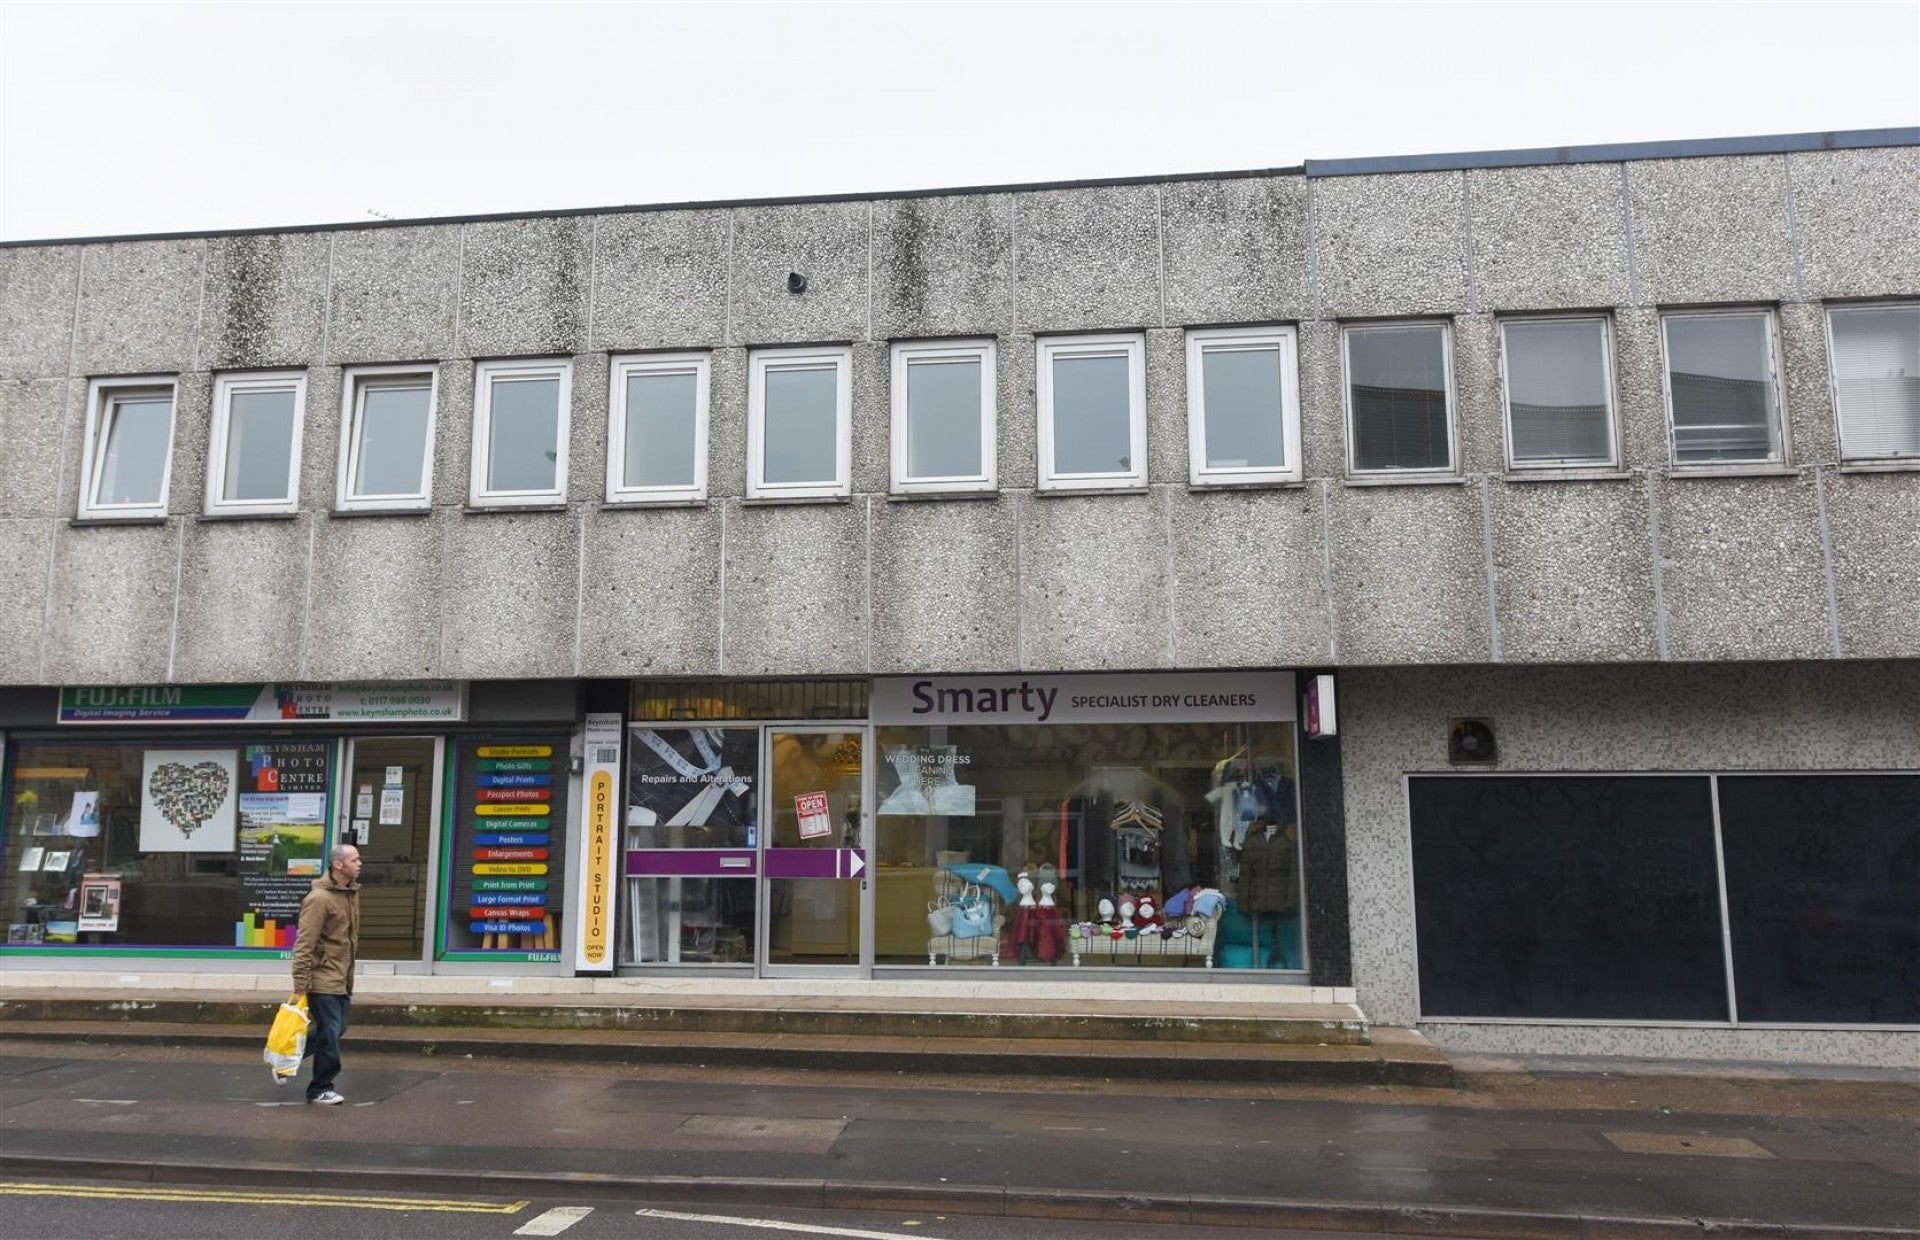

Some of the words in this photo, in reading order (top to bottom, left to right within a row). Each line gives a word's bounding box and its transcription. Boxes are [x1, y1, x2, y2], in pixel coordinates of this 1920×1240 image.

[912, 681, 1059, 722] Smarty
[1071, 695, 1148, 708] SPECIALIST
[1152, 695, 1180, 707] DRY
[1184, 694, 1257, 707] CLEANERS
[74, 709, 100, 719] Digital
[103, 709, 137, 719] Imaging
[139, 708, 171, 717] Service
[338, 706, 453, 719] www.keynshamphoto.co.uk
[262, 754, 325, 768] PHOTO
[884, 754, 935, 764] WEDDING
[937, 755, 971, 765] DRESS
[495, 762, 515, 770] Photo
[517, 762, 532, 770] Gifts
[267, 769, 324, 783] CENTRE
[492, 776, 514, 785] Digital
[515, 776, 535, 784] Prints
[641, 774, 678, 785] Repairs
[679, 774, 698, 783] and
[700, 774, 752, 784] Alterations
[912, 777, 941, 786] HERE
[487, 790, 515, 799] Passport
[516, 790, 539, 798] Photos
[800, 798, 824, 811] OPEN
[486, 820, 508, 829] Digital
[509, 820, 537, 828] Cameras
[595, 782, 605, 865] PORTRAIT
[498, 836, 523, 844] Posters
[488, 850, 534, 859] Enlargements
[483, 881, 499, 889] Print
[478, 895, 496, 904] Large
[498, 895, 521, 903] Format
[523, 895, 540, 903] Print
[592, 873, 601, 937] STUDIO
[484, 909, 507, 917] Canvas
[510, 909, 530, 918] Wraps
[484, 923, 498, 931] Visa
[499, 923, 506, 931] ID
[508, 923, 531, 931] Photos
